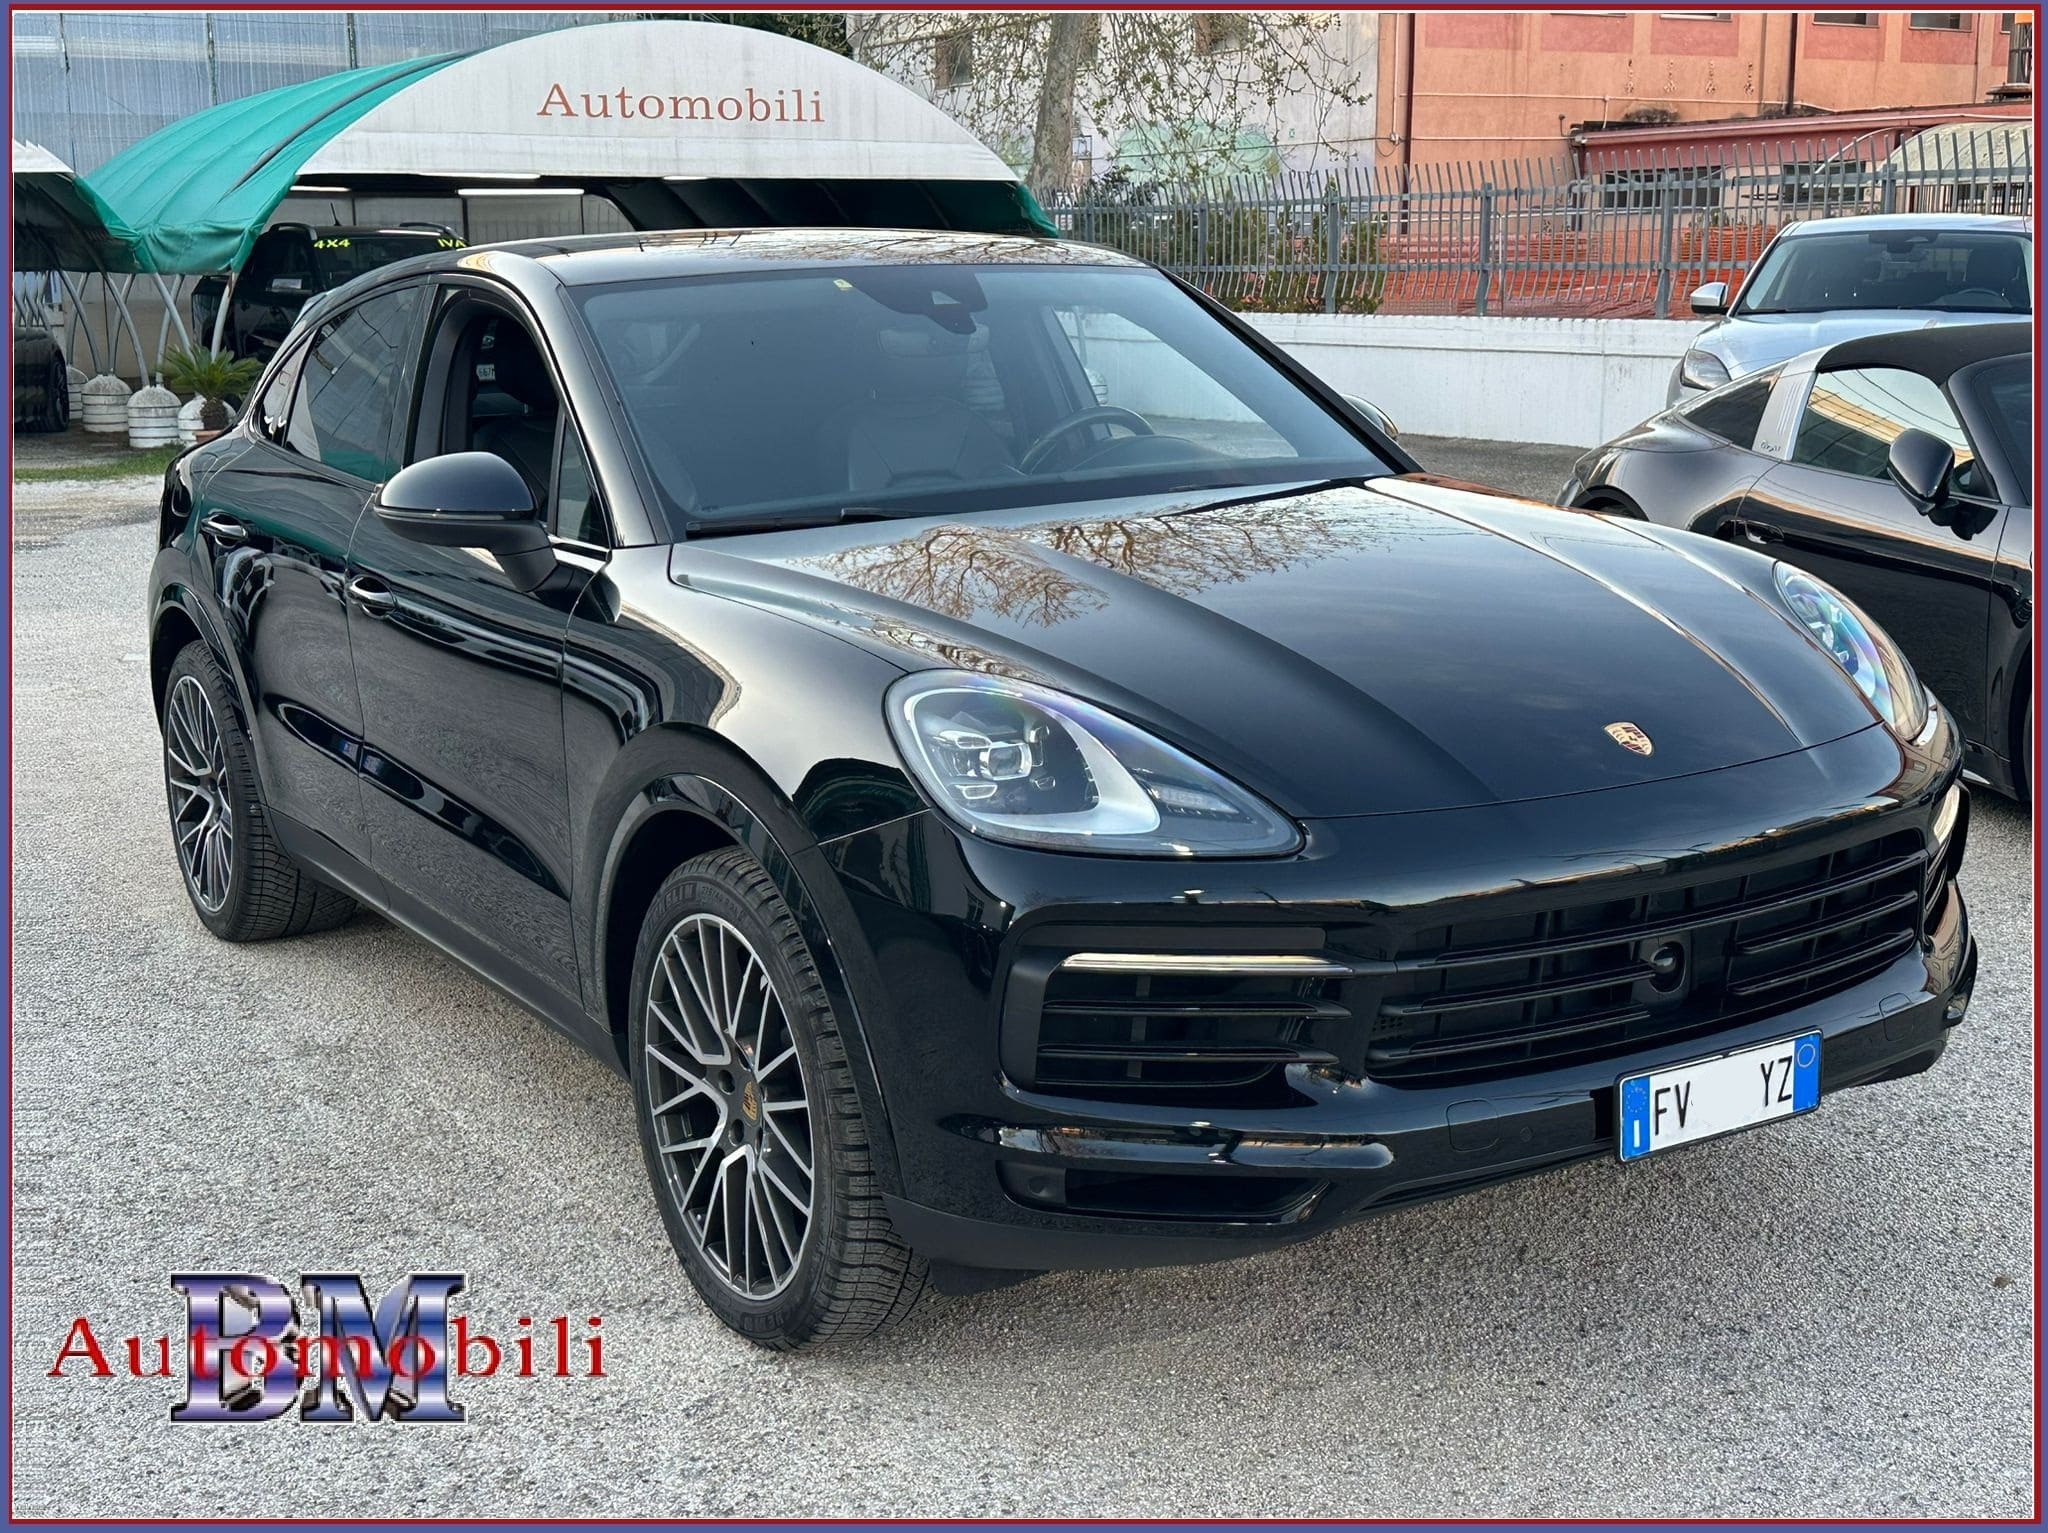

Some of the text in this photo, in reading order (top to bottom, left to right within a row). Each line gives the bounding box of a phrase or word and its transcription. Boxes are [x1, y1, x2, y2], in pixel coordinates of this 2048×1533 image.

[536, 82, 826, 123] Automobili
[1654, 1055, 1794, 1137] FV YZ
